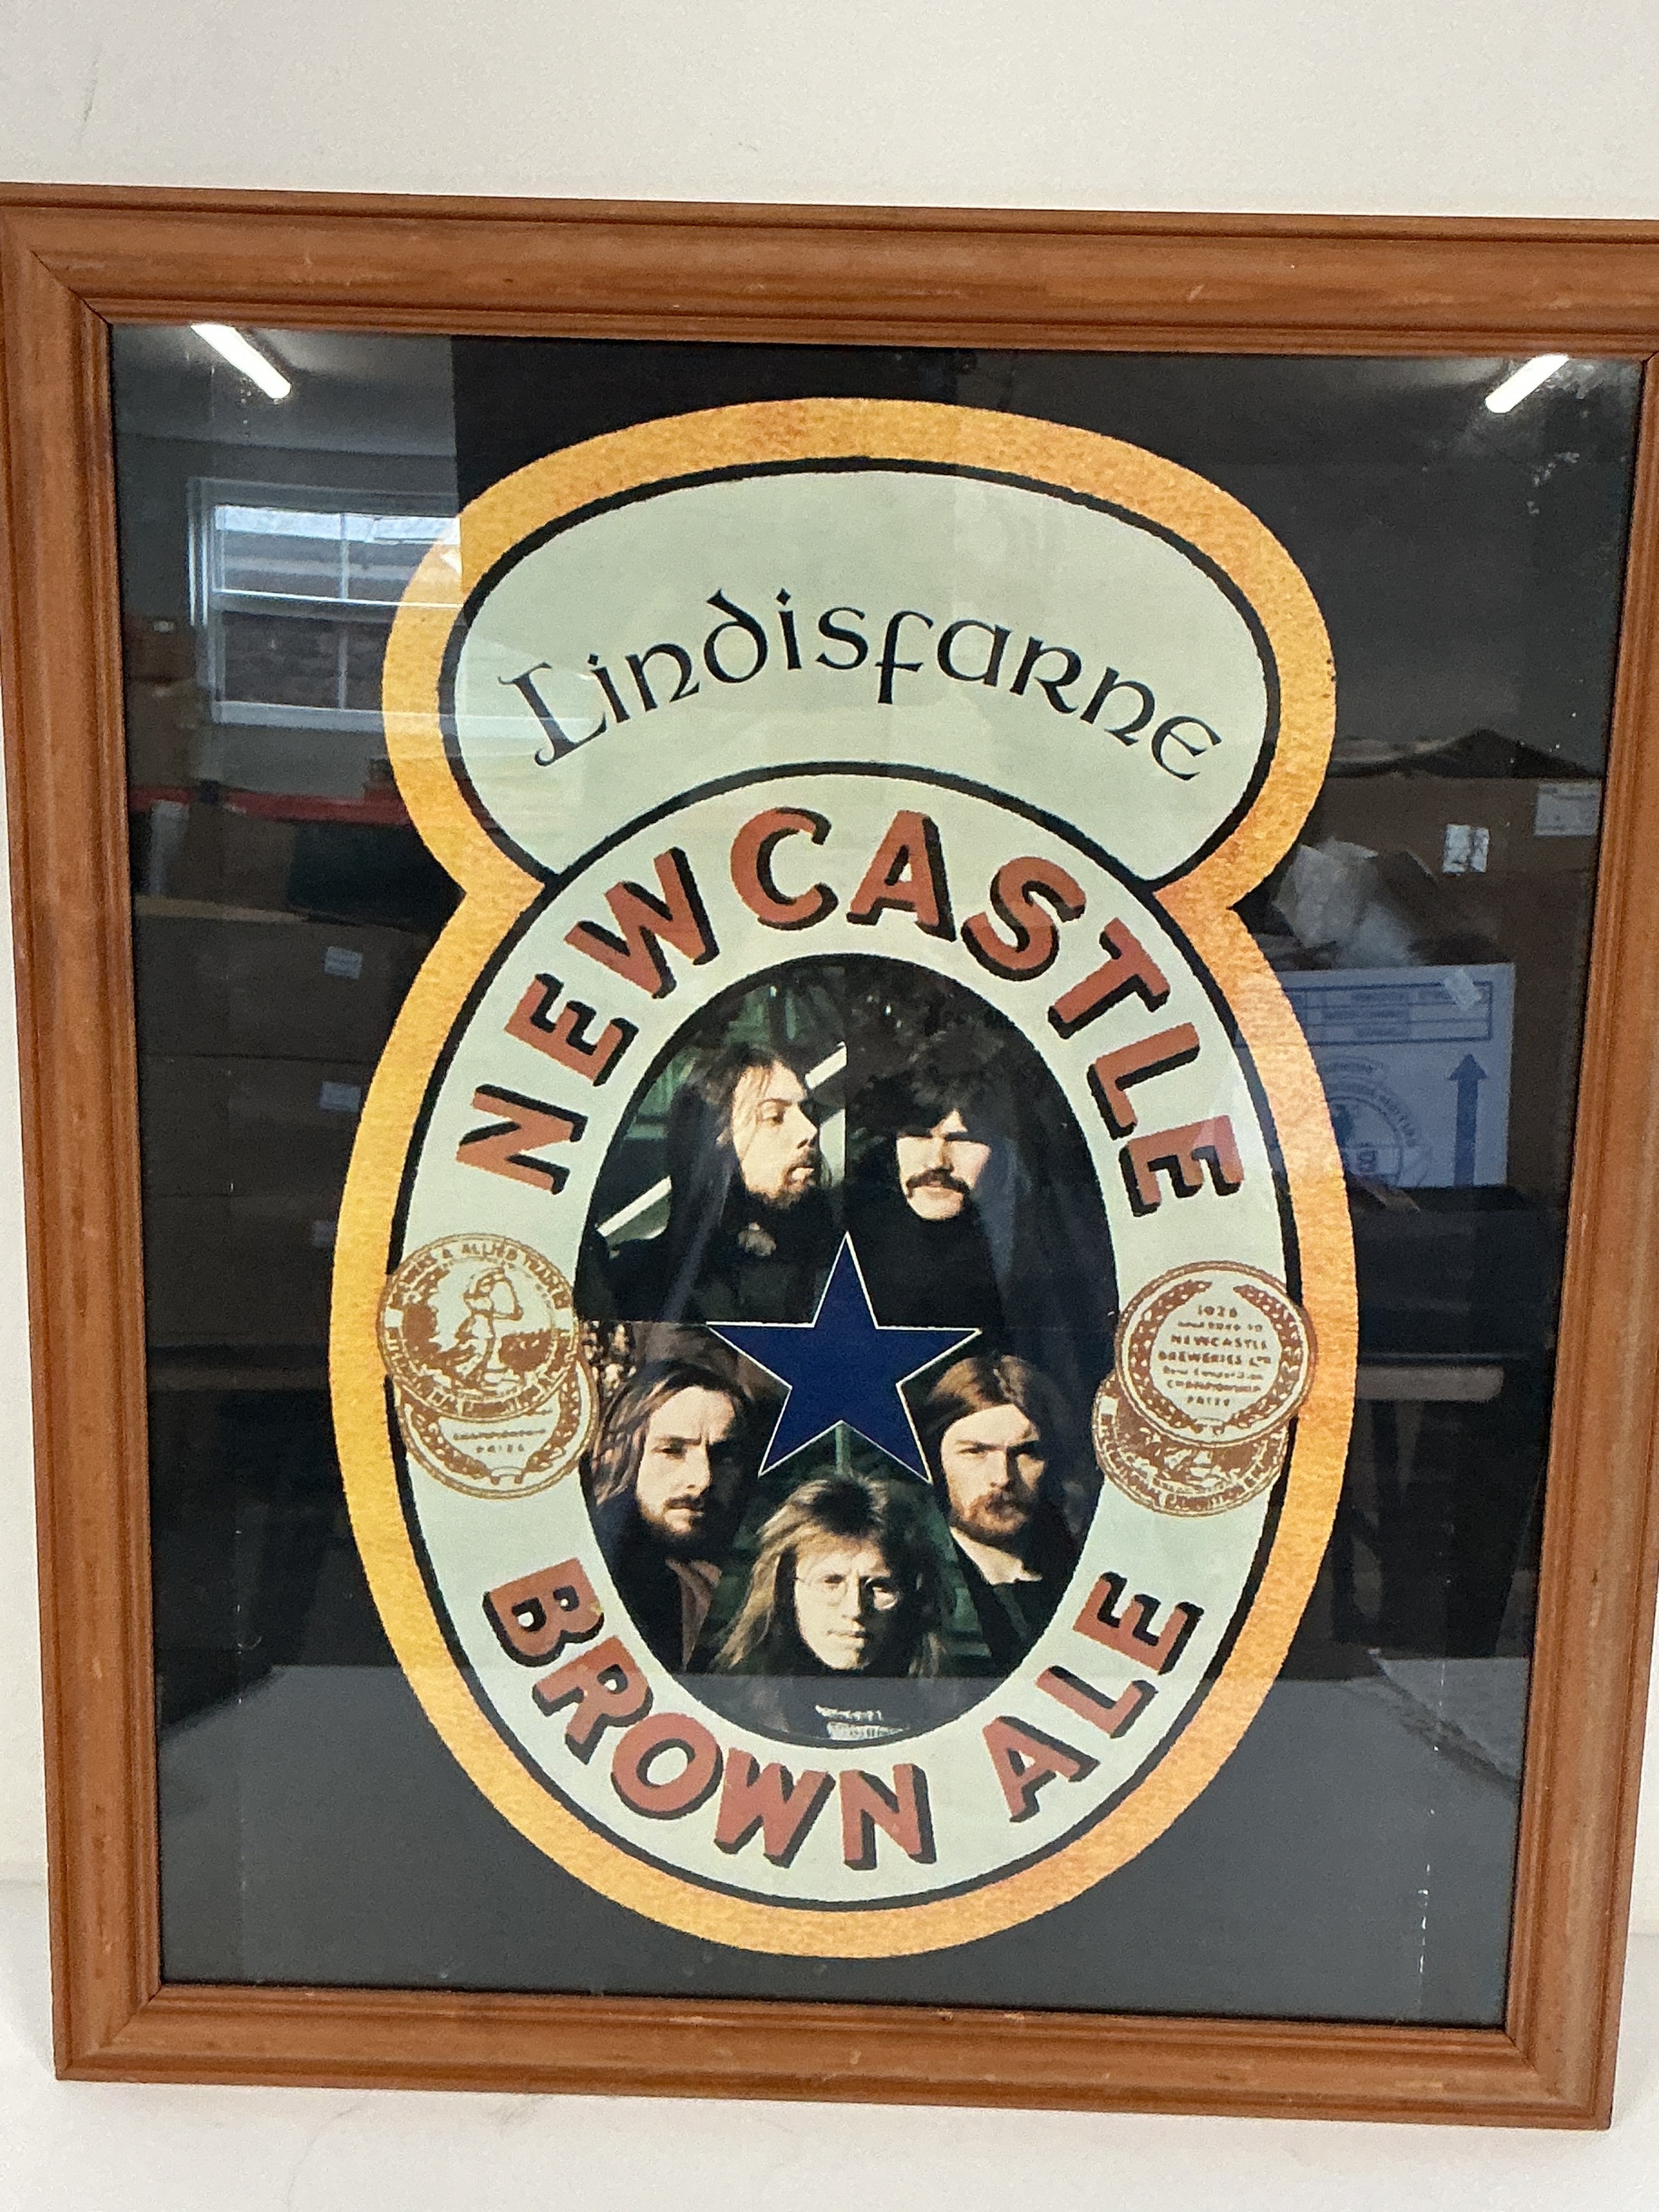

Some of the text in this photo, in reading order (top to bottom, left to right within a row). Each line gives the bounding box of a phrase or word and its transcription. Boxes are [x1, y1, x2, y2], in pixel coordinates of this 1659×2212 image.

[499, 587, 1222, 780] Lindisfarne
[459, 808, 1242, 1217] NEWCASTLE
[483, 1557, 1203, 1866] BROWN ALE
